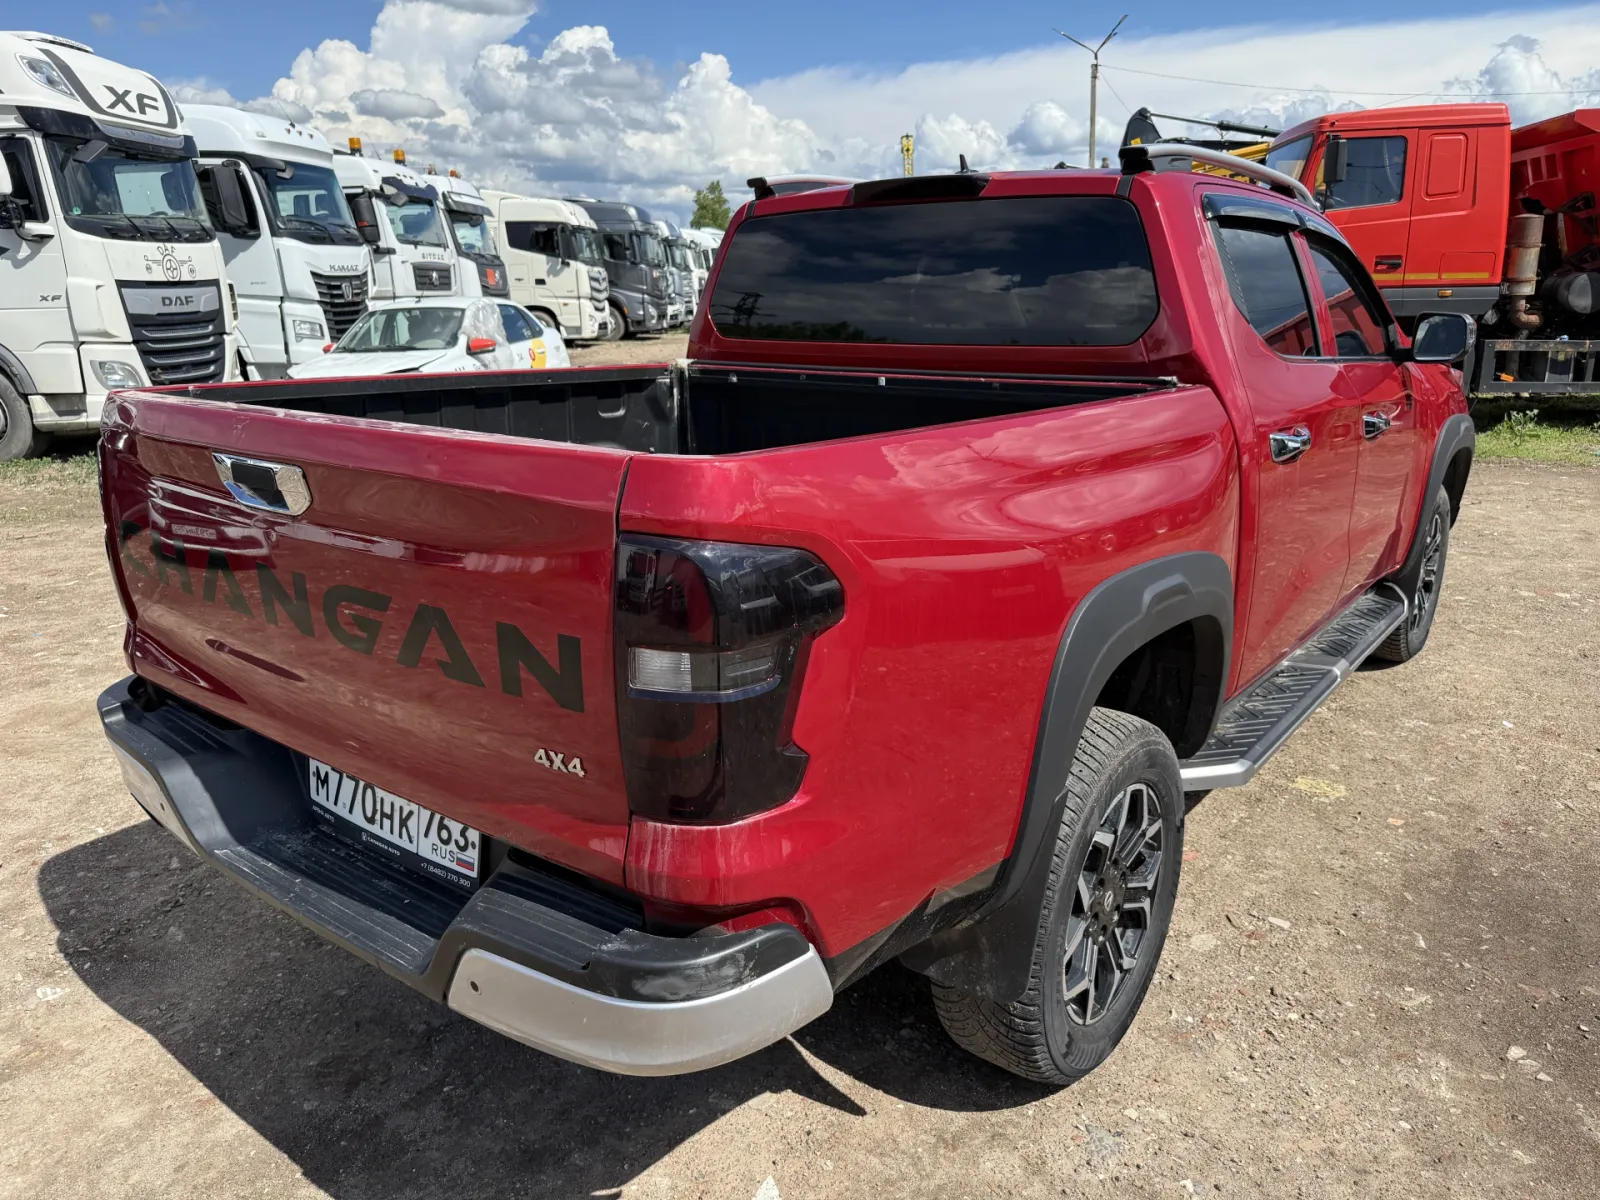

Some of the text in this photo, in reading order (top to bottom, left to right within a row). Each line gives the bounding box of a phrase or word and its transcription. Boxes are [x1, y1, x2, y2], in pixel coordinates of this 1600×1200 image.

[102, 84, 159, 116] XF
[156, 241, 176, 256] DAF
[329, 264, 360, 272] KAMAZ
[39, 294, 63, 302] XF
[161, 295, 194, 307] DAF
[121, 519, 585, 713] CHANGAN
[533, 748, 587, 778] 4X4
[431, 843, 456, 863] RUS
